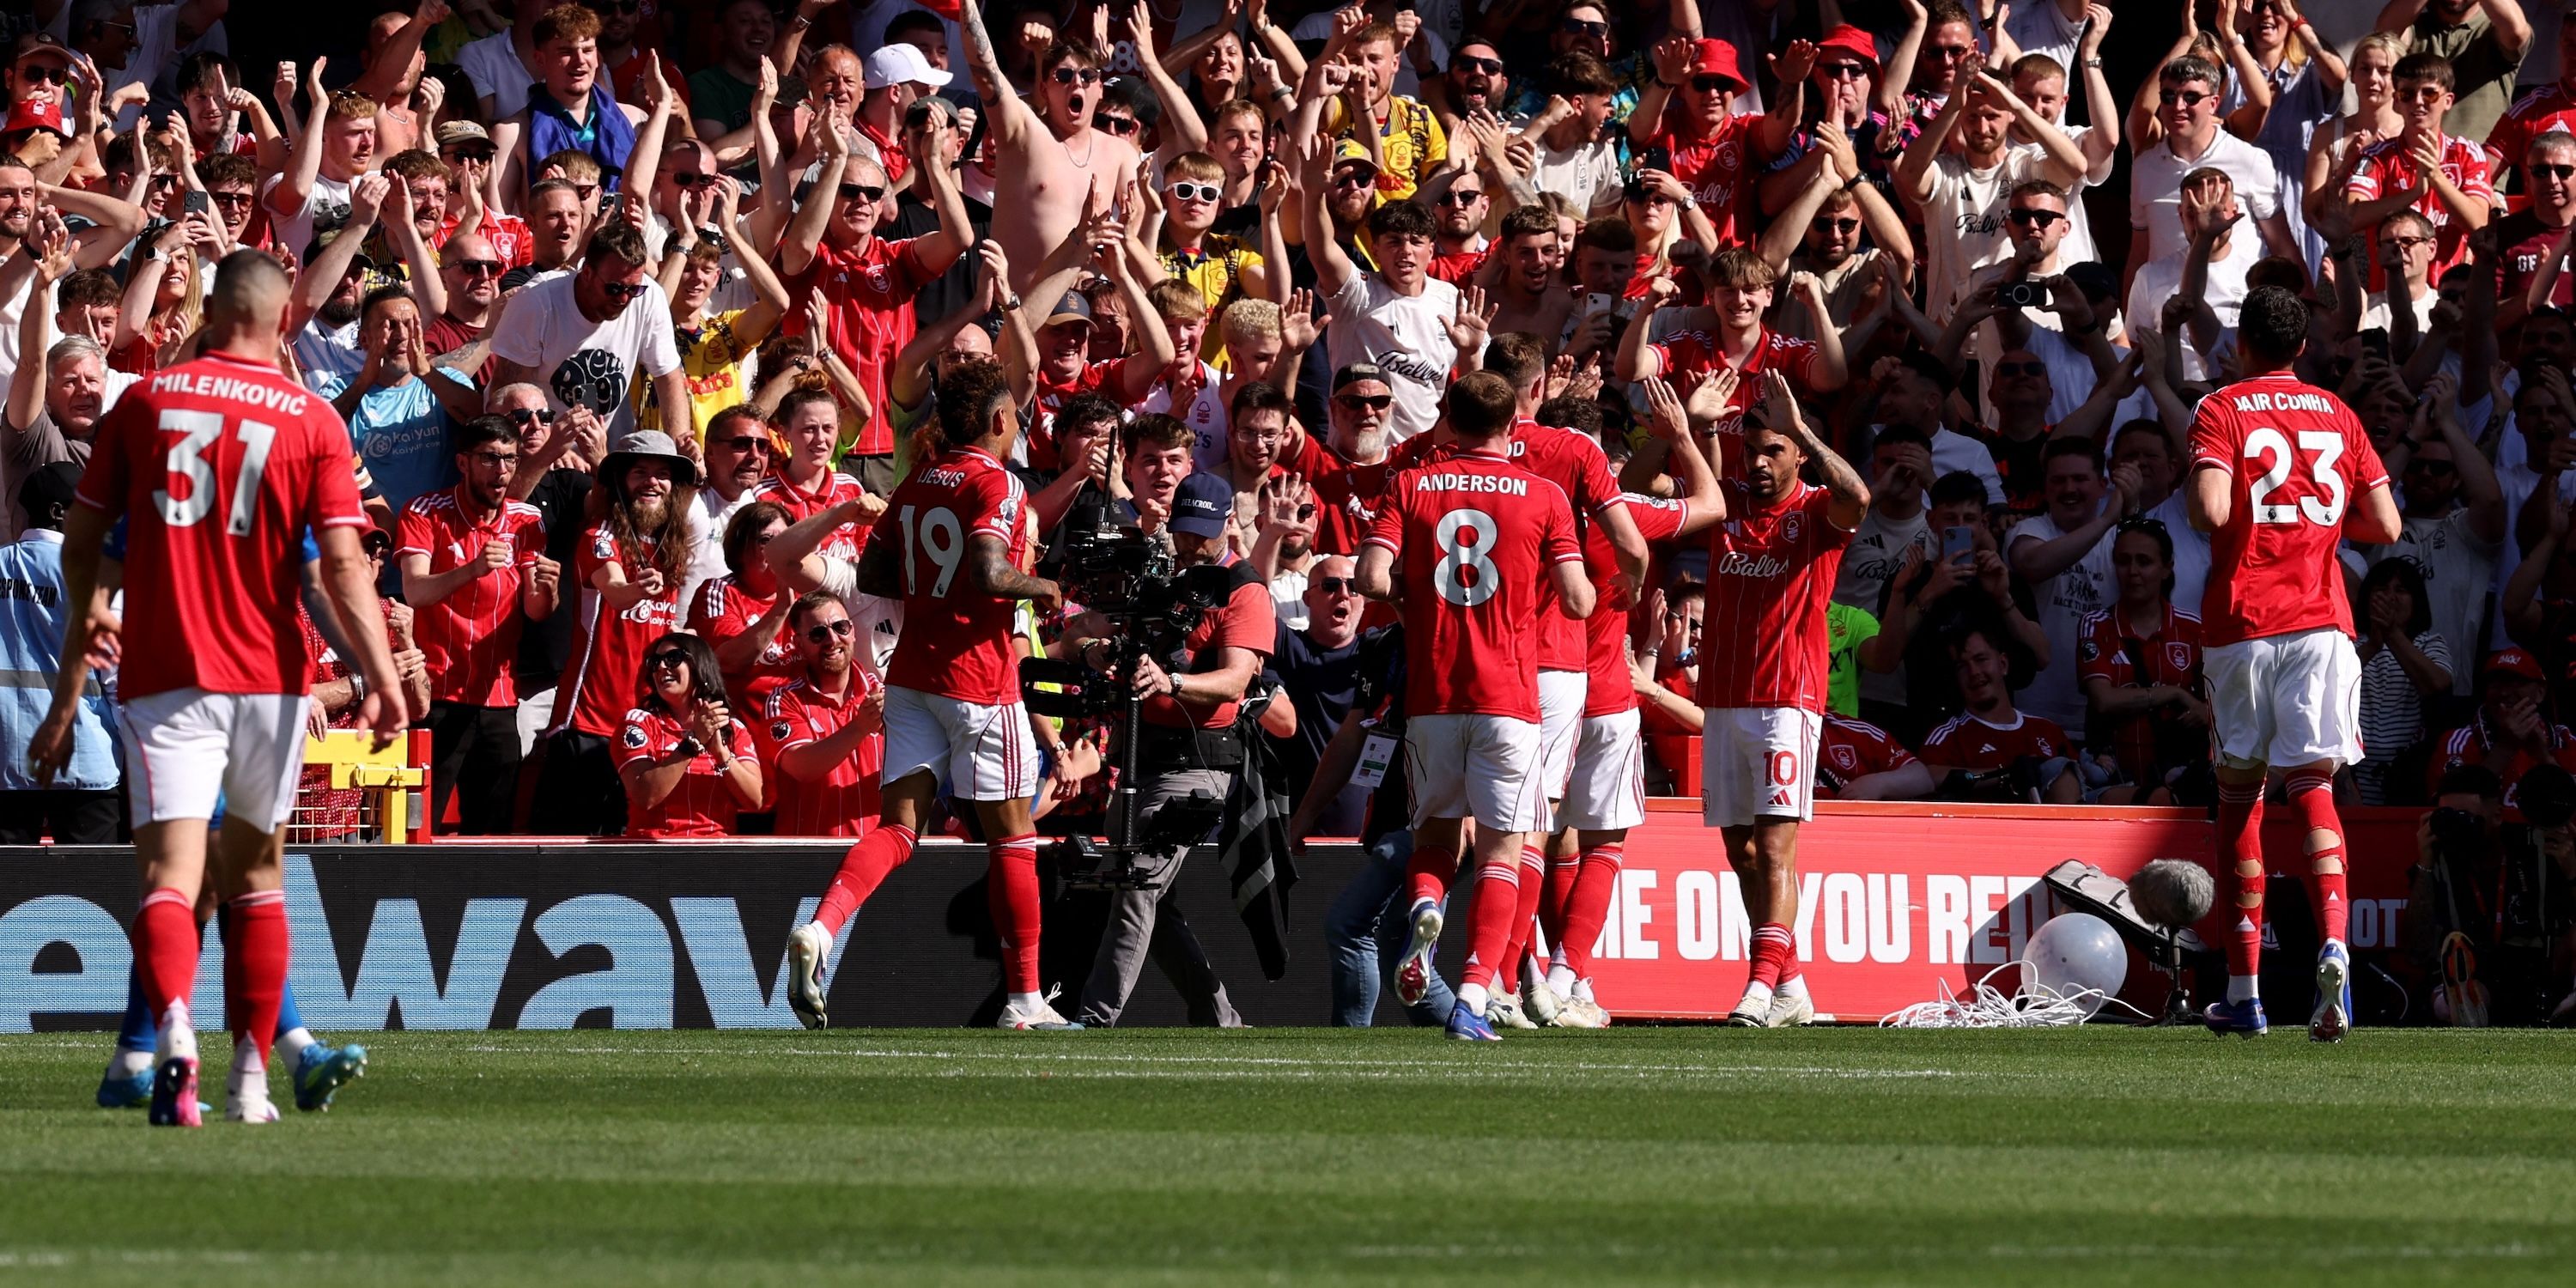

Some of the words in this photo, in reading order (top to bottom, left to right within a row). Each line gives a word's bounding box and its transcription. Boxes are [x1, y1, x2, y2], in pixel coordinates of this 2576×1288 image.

[150, 373, 307, 416] MILENKOVIĆ
[1376, 350, 1444, 386] Bally's
[2233, 392, 2274, 412] JAIR
[2275, 392, 2335, 415] CUNHA
[152, 408, 276, 538] 31
[1417, 472, 1527, 496] ANDERSON
[2244, 427, 2346, 527] 23
[899, 504, 964, 598] 19
[1434, 508, 1499, 606] 8
[1764, 750, 1798, 787] 10
[1926, 873, 2063, 964] RED
